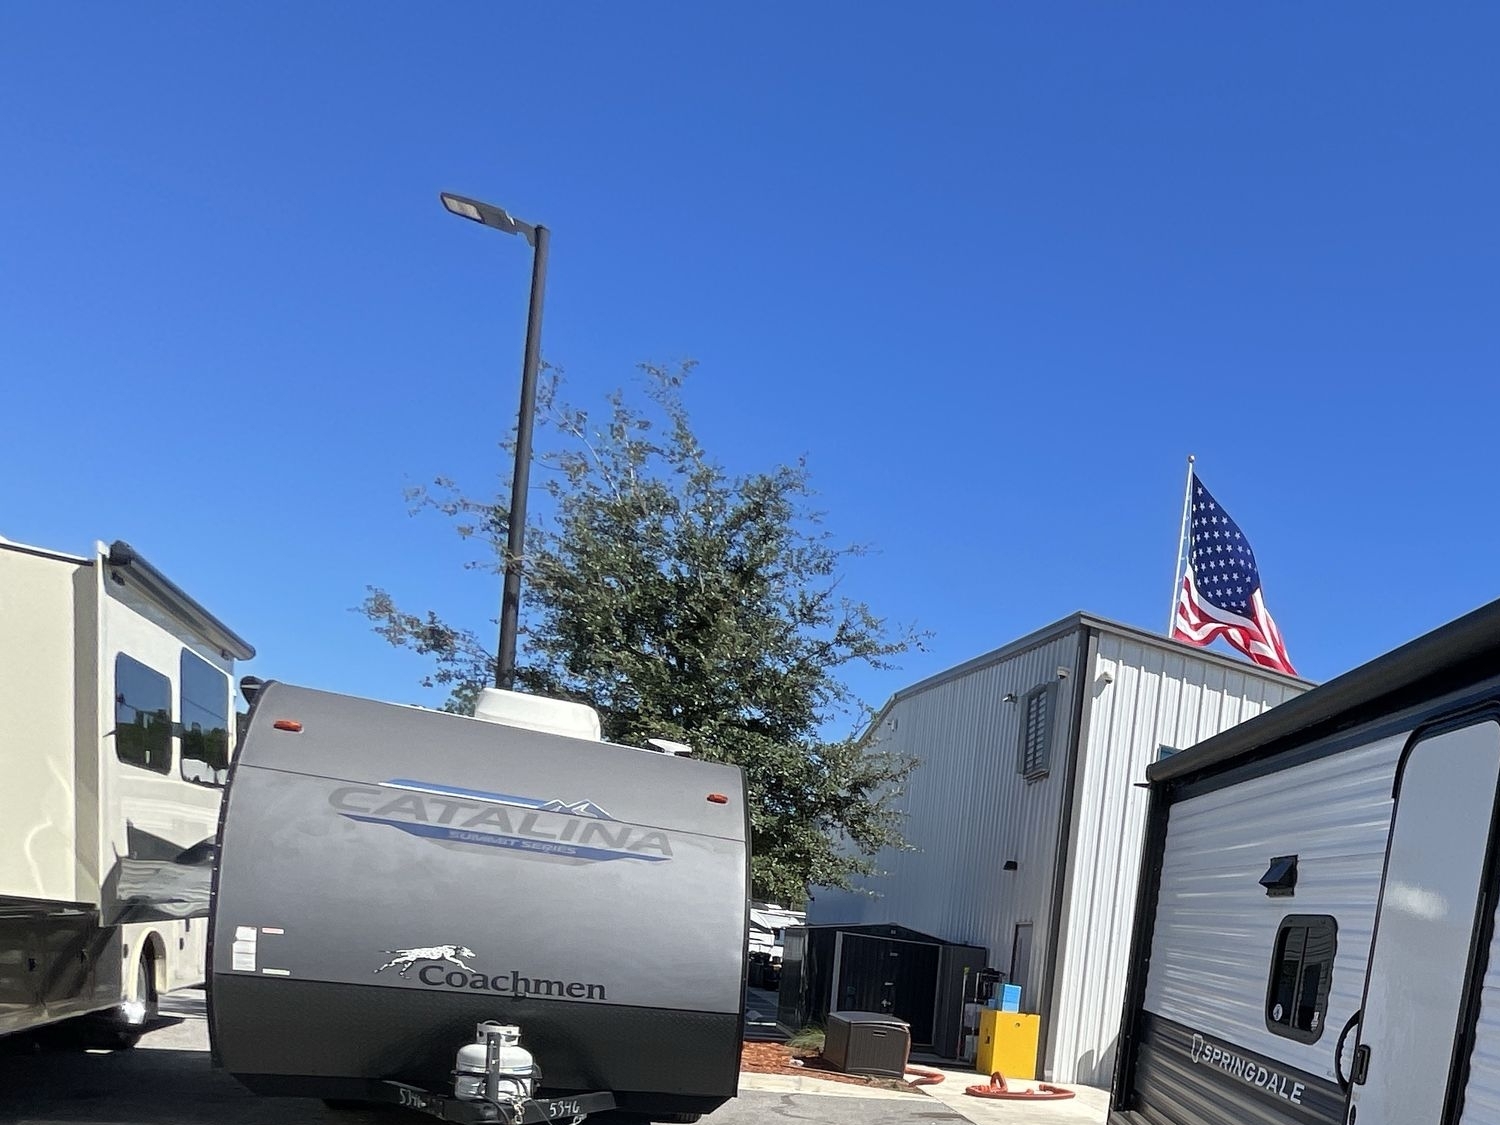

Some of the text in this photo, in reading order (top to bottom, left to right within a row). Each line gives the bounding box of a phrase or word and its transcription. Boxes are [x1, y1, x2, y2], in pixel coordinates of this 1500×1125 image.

[328, 786, 674, 857] CATALINA
[448, 830, 577, 855] SUMMIT SERIES
[418, 965, 607, 1000] Coachmen
[1202, 1045, 1305, 1104] SPRINGDALE
